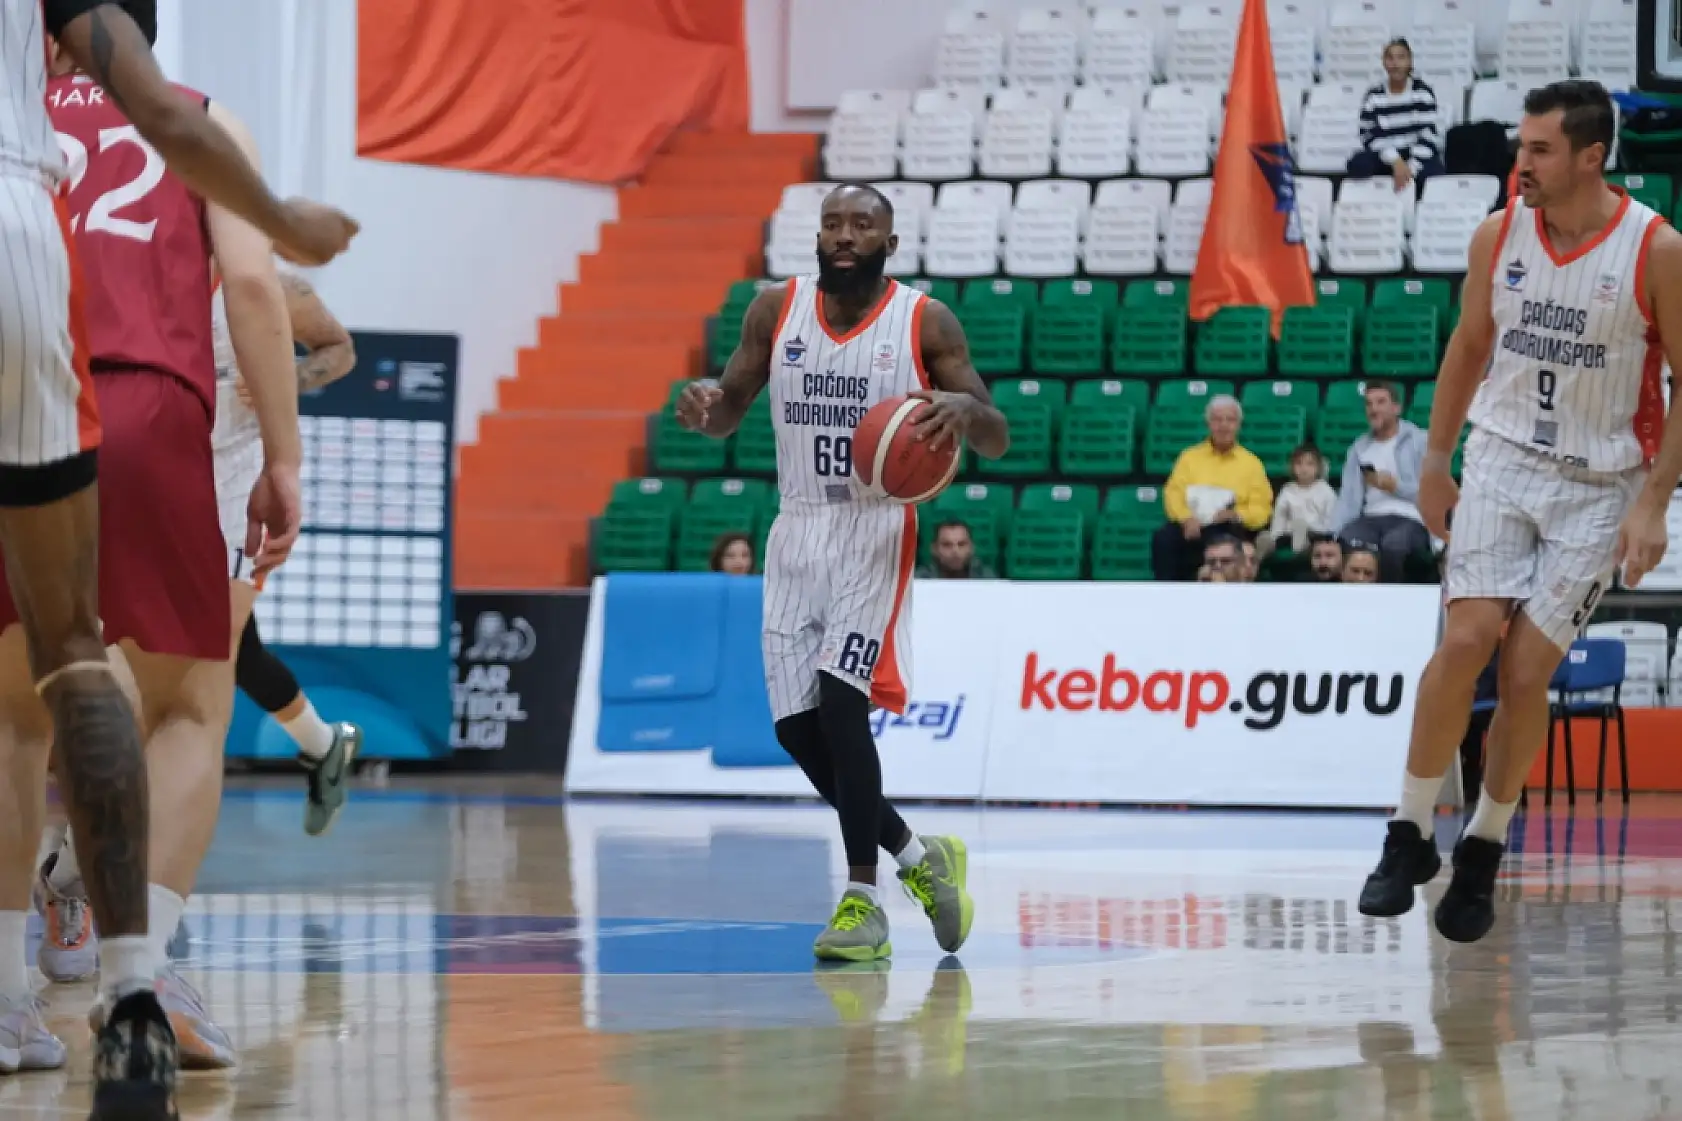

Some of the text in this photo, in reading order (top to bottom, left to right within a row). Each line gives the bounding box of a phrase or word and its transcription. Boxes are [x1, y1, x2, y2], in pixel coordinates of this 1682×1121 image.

[1521, 298, 1587, 339] ÇAĞDAŞ
[1502, 329, 1605, 368] BODRUMSPOR
[803, 369, 869, 404] ÇAĞDAŞ
[1537, 369, 1556, 411] 9
[814, 434, 852, 478] 69
[839, 631, 880, 681] 69
[1019, 651, 1404, 730] kebap.guru
